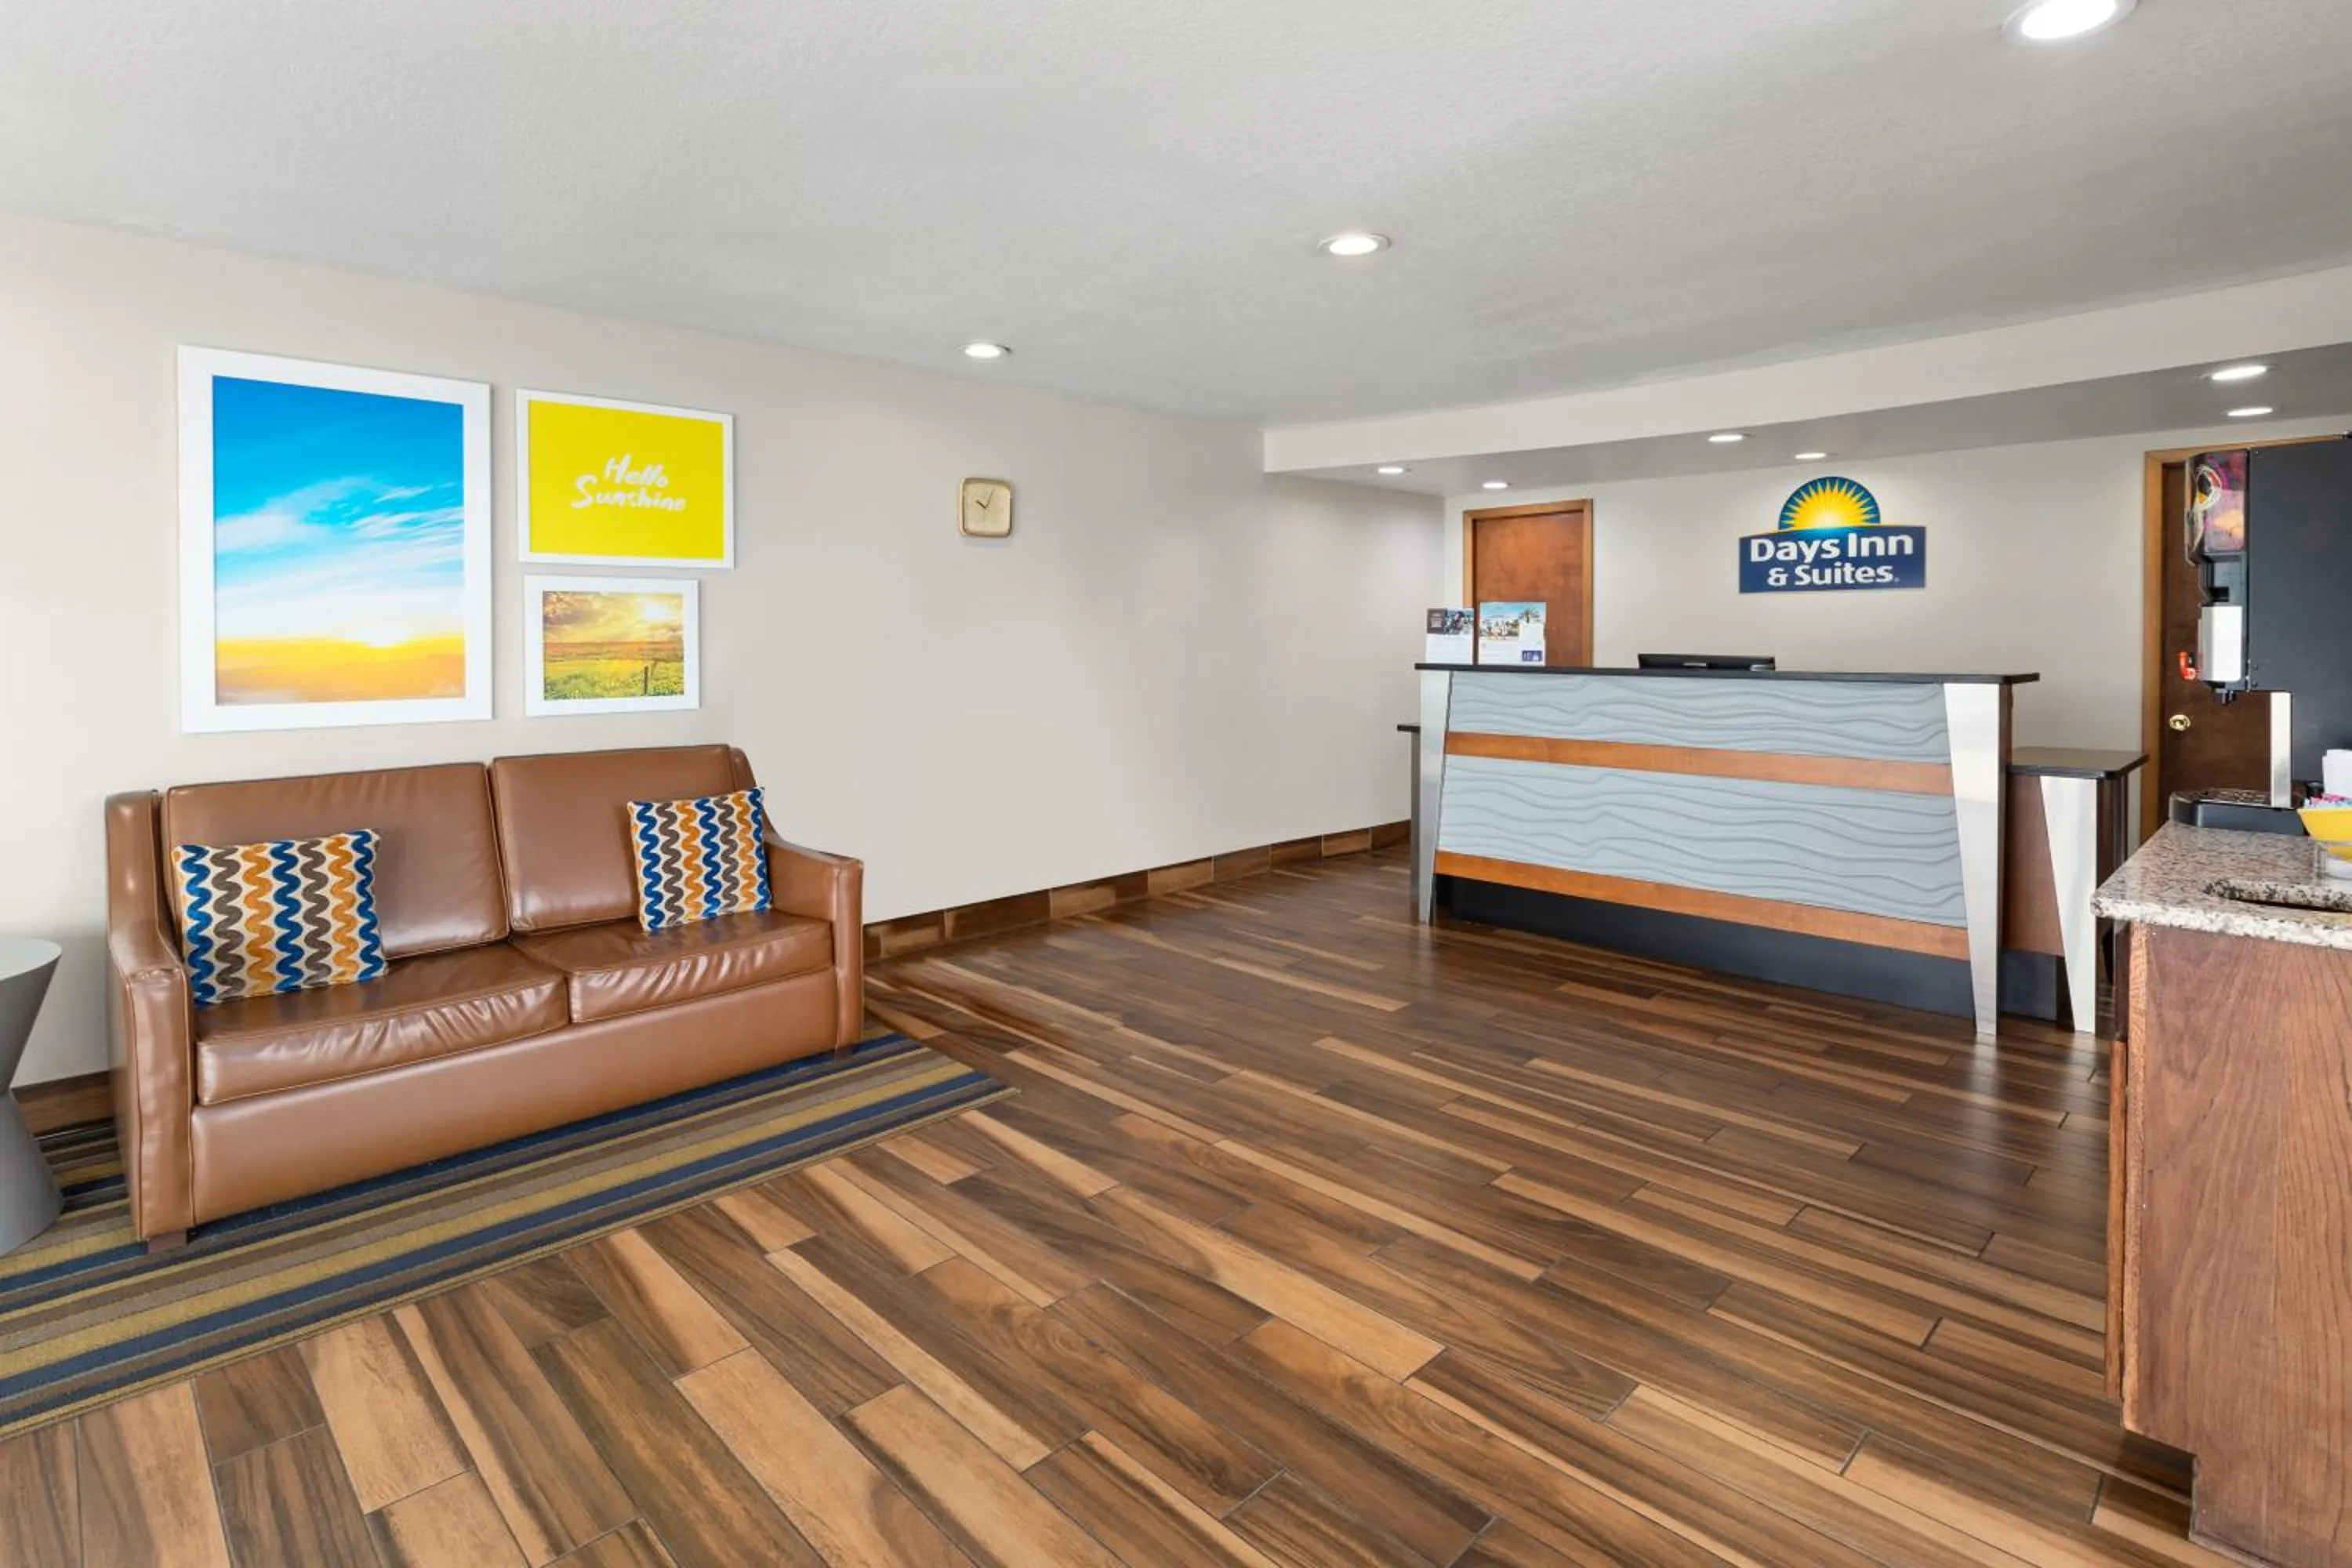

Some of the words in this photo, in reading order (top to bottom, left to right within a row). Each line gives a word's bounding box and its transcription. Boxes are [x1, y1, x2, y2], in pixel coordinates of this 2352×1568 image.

[604, 453, 670, 488] Hello
[570, 474, 687, 511] Sunshine
[1750, 538, 1841, 563] Days
[1847, 532, 1914, 557] Inn
[1766, 566, 1788, 586] &
[1794, 561, 1894, 586] Suites
